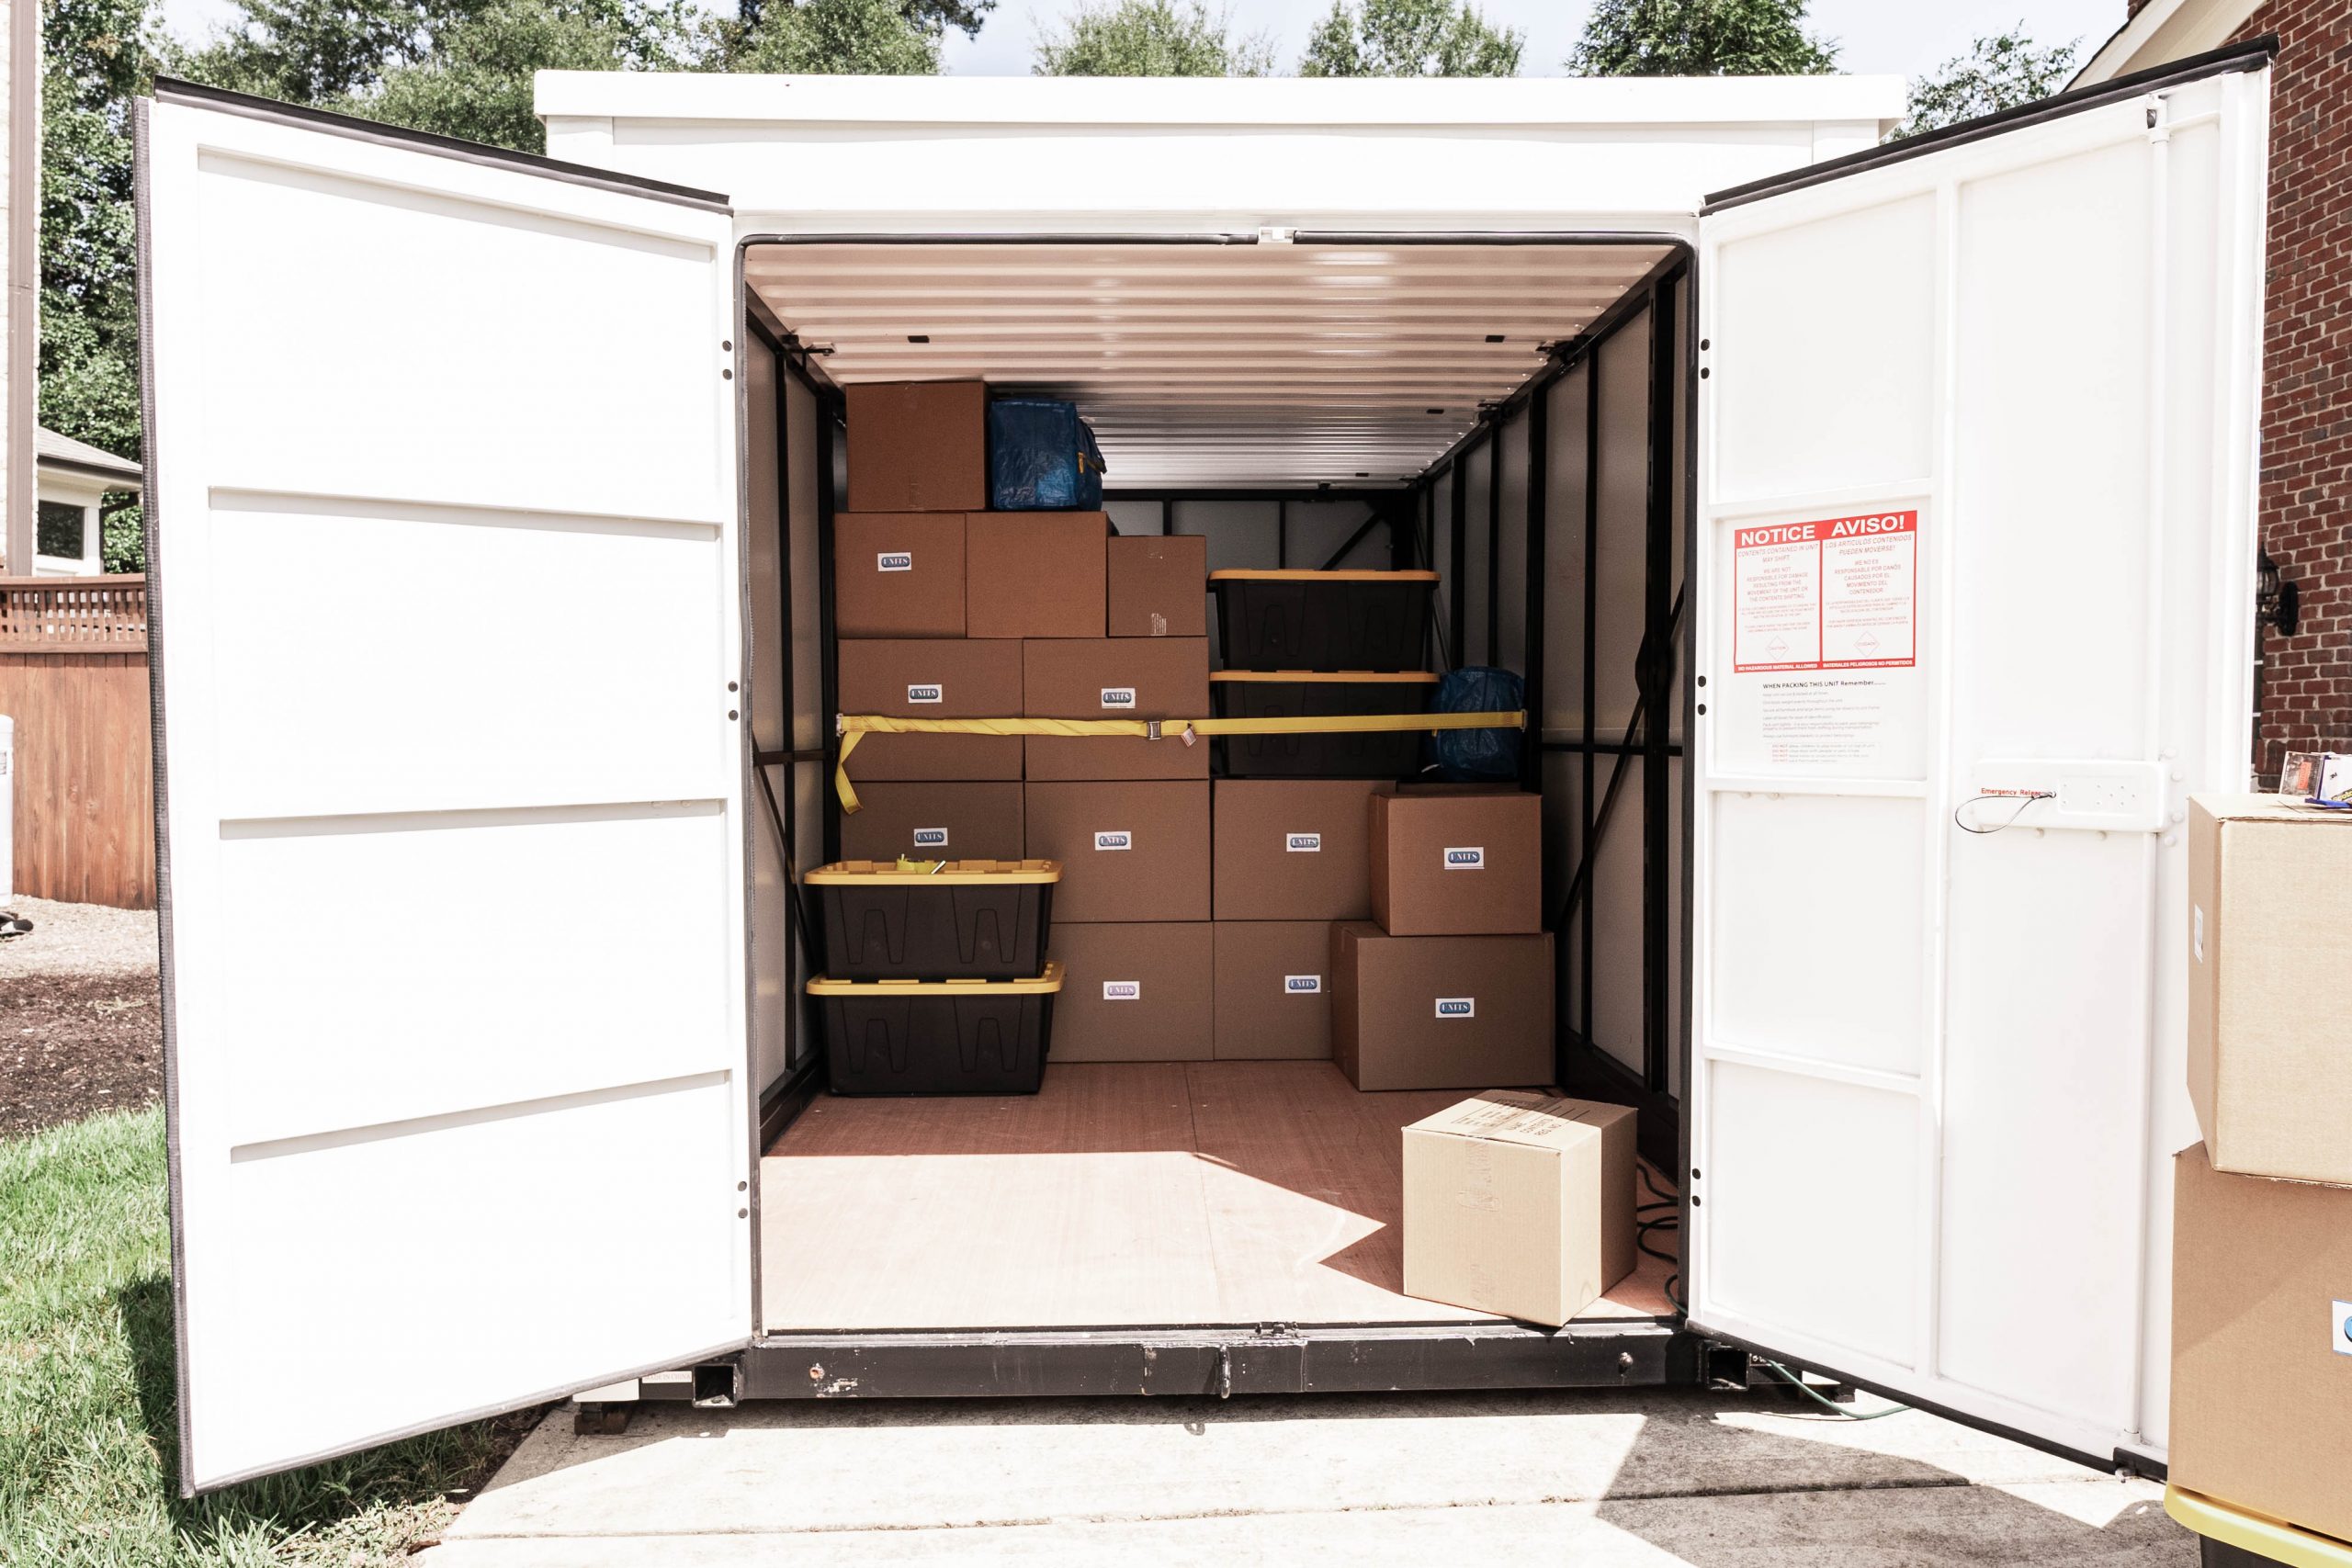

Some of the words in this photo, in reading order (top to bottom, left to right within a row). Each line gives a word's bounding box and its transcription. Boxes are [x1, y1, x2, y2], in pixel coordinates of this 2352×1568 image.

[1831, 514, 1905, 536] AVISO!
[1741, 525, 1815, 546] NOTICE
[1872, 534, 1912, 545] CONTENIDOS
[1738, 548, 1766, 558] CONTENTS
[1768, 546, 1797, 555] CONTAINED
[1839, 547, 1863, 556] PUEDEN
[882, 558, 909, 567] UNITS
[910, 690, 937, 699] UNITS
[1104, 693, 1131, 701] UNITS
[917, 833, 944, 841] UNITS
[1100, 836, 1126, 844] UNITS
[1292, 838, 1317, 846] UNITS
[1449, 852, 1479, 862] UNITS
[1290, 980, 1317, 988] UNITS
[1109, 985, 1135, 994] UNITS
[1441, 1002, 1469, 1012] UNITS
